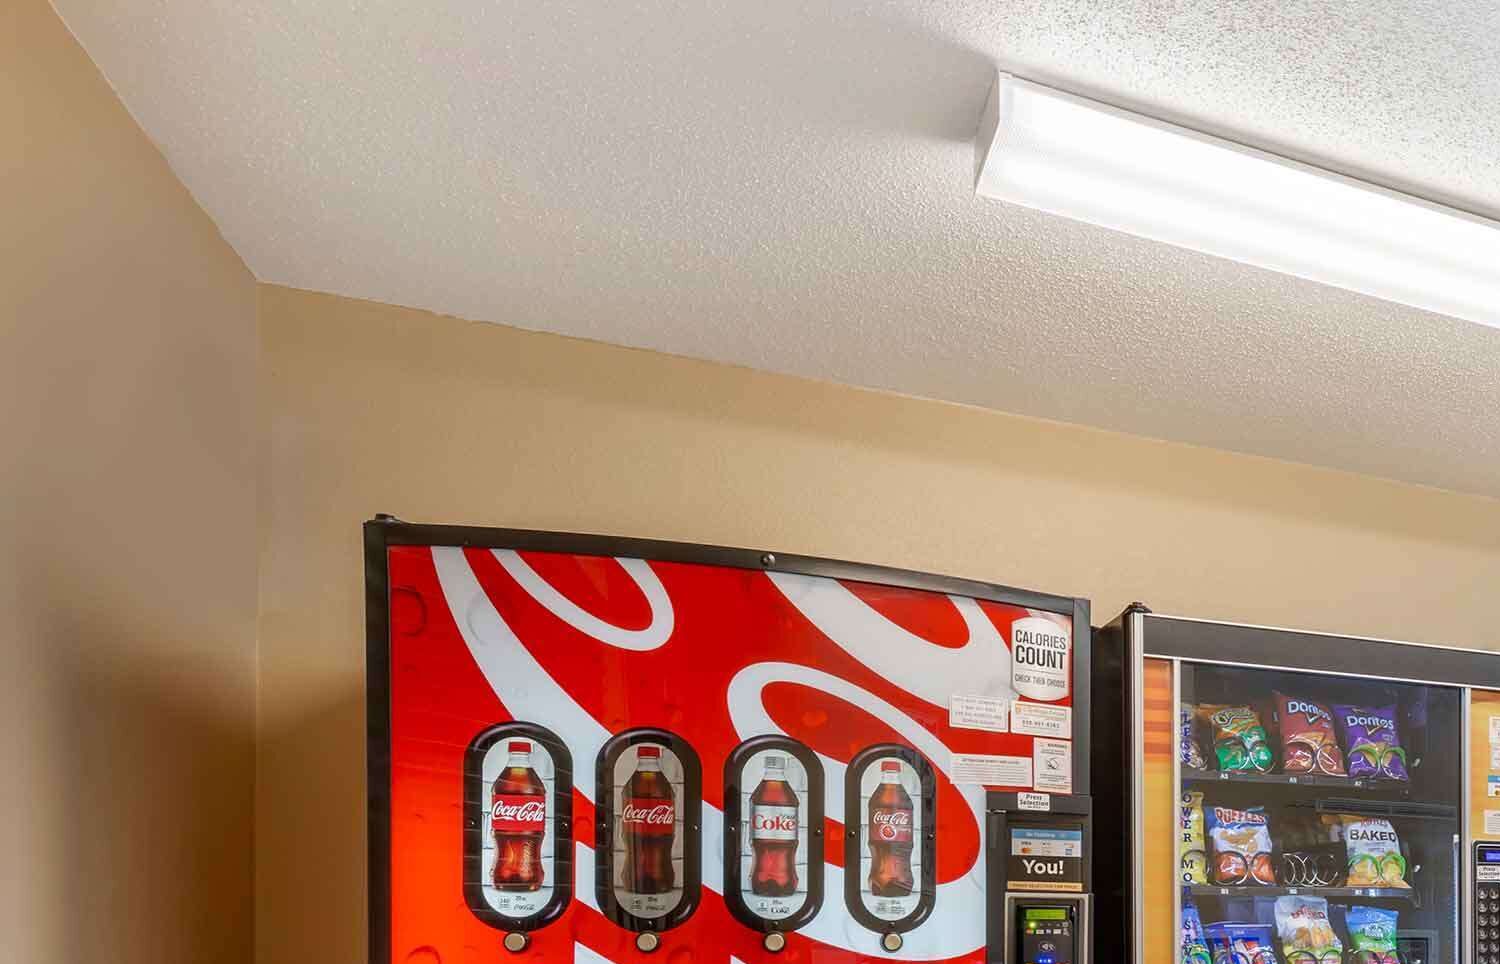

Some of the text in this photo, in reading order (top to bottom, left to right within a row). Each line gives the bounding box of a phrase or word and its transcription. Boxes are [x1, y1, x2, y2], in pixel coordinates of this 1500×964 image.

[1015, 629, 1066, 649] CALORIES
[1015, 645, 1066, 670] COUNT
[1015, 673, 1031, 683] CHECK
[1346, 715, 1394, 730] Doritos
[492, 800, 545, 822] Coca-Cola
[623, 803, 674, 824] Coca-Cola
[752, 813, 797, 831] Coke
[1350, 829, 1397, 843] BAKED
[1022, 859, 1064, 875] You!
